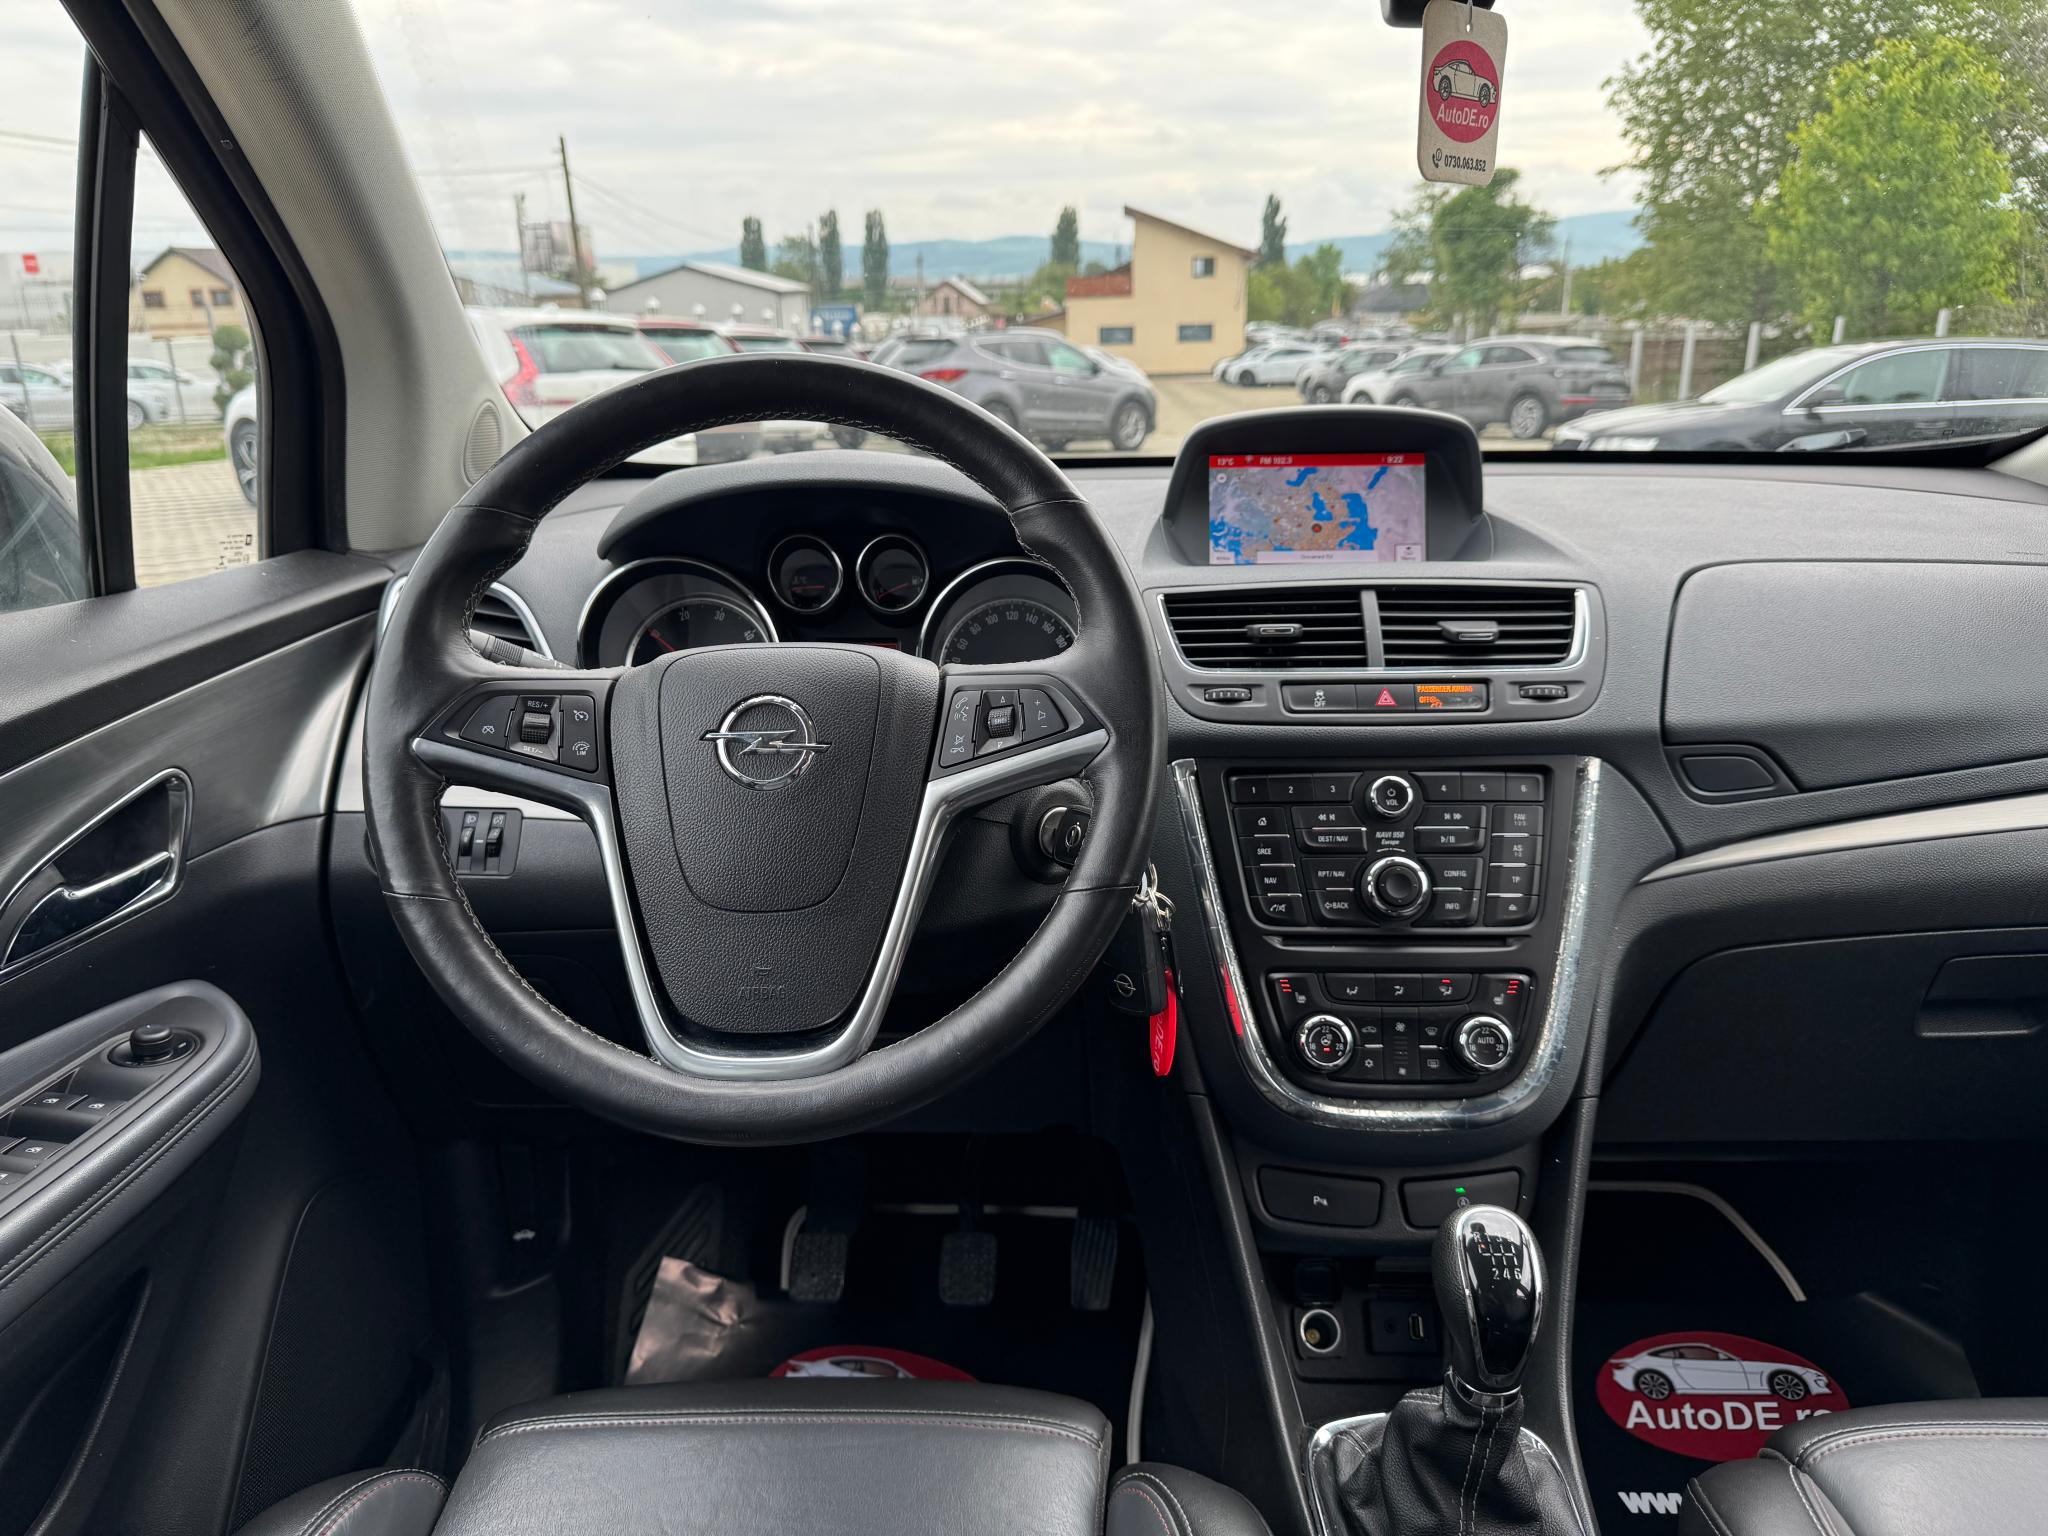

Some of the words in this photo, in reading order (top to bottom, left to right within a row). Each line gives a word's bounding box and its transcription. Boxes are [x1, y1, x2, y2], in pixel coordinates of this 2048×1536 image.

[1436, 103, 1489, 129] AutoDE.ro
[1444, 154, 1487, 172] 0730.063.852
[1259, 456, 1272, 465] FM
[679, 610, 690, 622] 20
[714, 610, 725, 622] 30
[985, 613, 999, 626] 100
[1006, 610, 1019, 621] 120
[1025, 613, 1038, 625] 140
[969, 623, 982, 636] 80
[1041, 620, 1056, 635] 160
[956, 638, 969, 650] 60
[1055, 634, 1068, 649] 180
[1513, 813, 1526, 821] FAV
[1317, 835, 1349, 843] DEST/NAV
[1376, 831, 1392, 839] NAVI
[1392, 831, 1404, 839] 950
[1257, 847, 1272, 855] SRCE
[1481, 1026, 1490, 1034] 22
[1477, 1036, 1495, 1044] AUTO
[1492, 1268, 1500, 1280] 2
[1503, 1268, 1511, 1279] 4
[1514, 1268, 1522, 1279] 6
